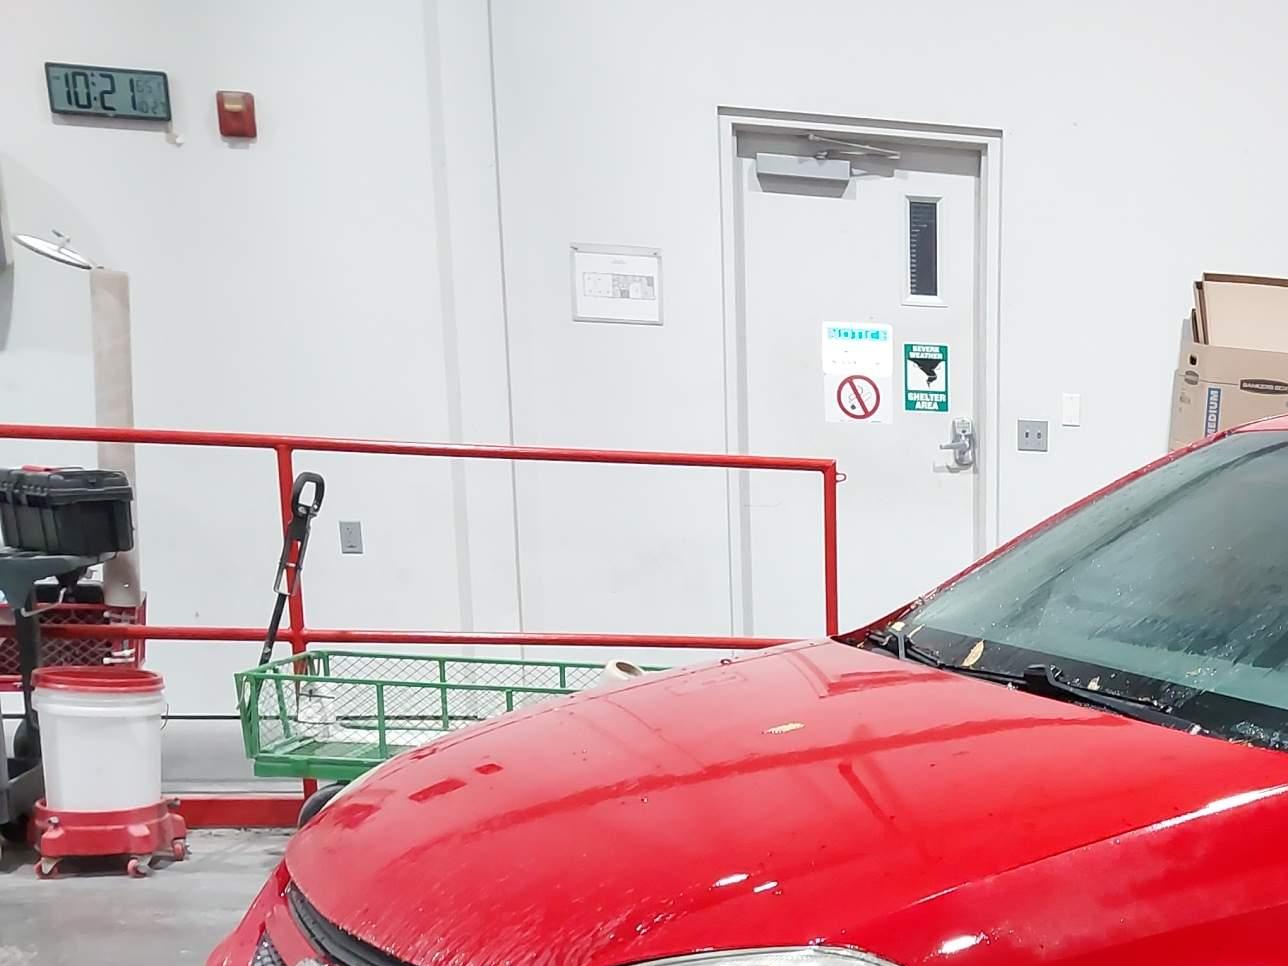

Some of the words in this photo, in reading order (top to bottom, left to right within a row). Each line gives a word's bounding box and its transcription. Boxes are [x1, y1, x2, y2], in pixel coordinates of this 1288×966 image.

[64, 71, 137, 111] 10:21
[909, 351, 943, 359] WEATHER
[907, 392, 946, 402] SHELTER
[914, 400, 940, 410] AREA
